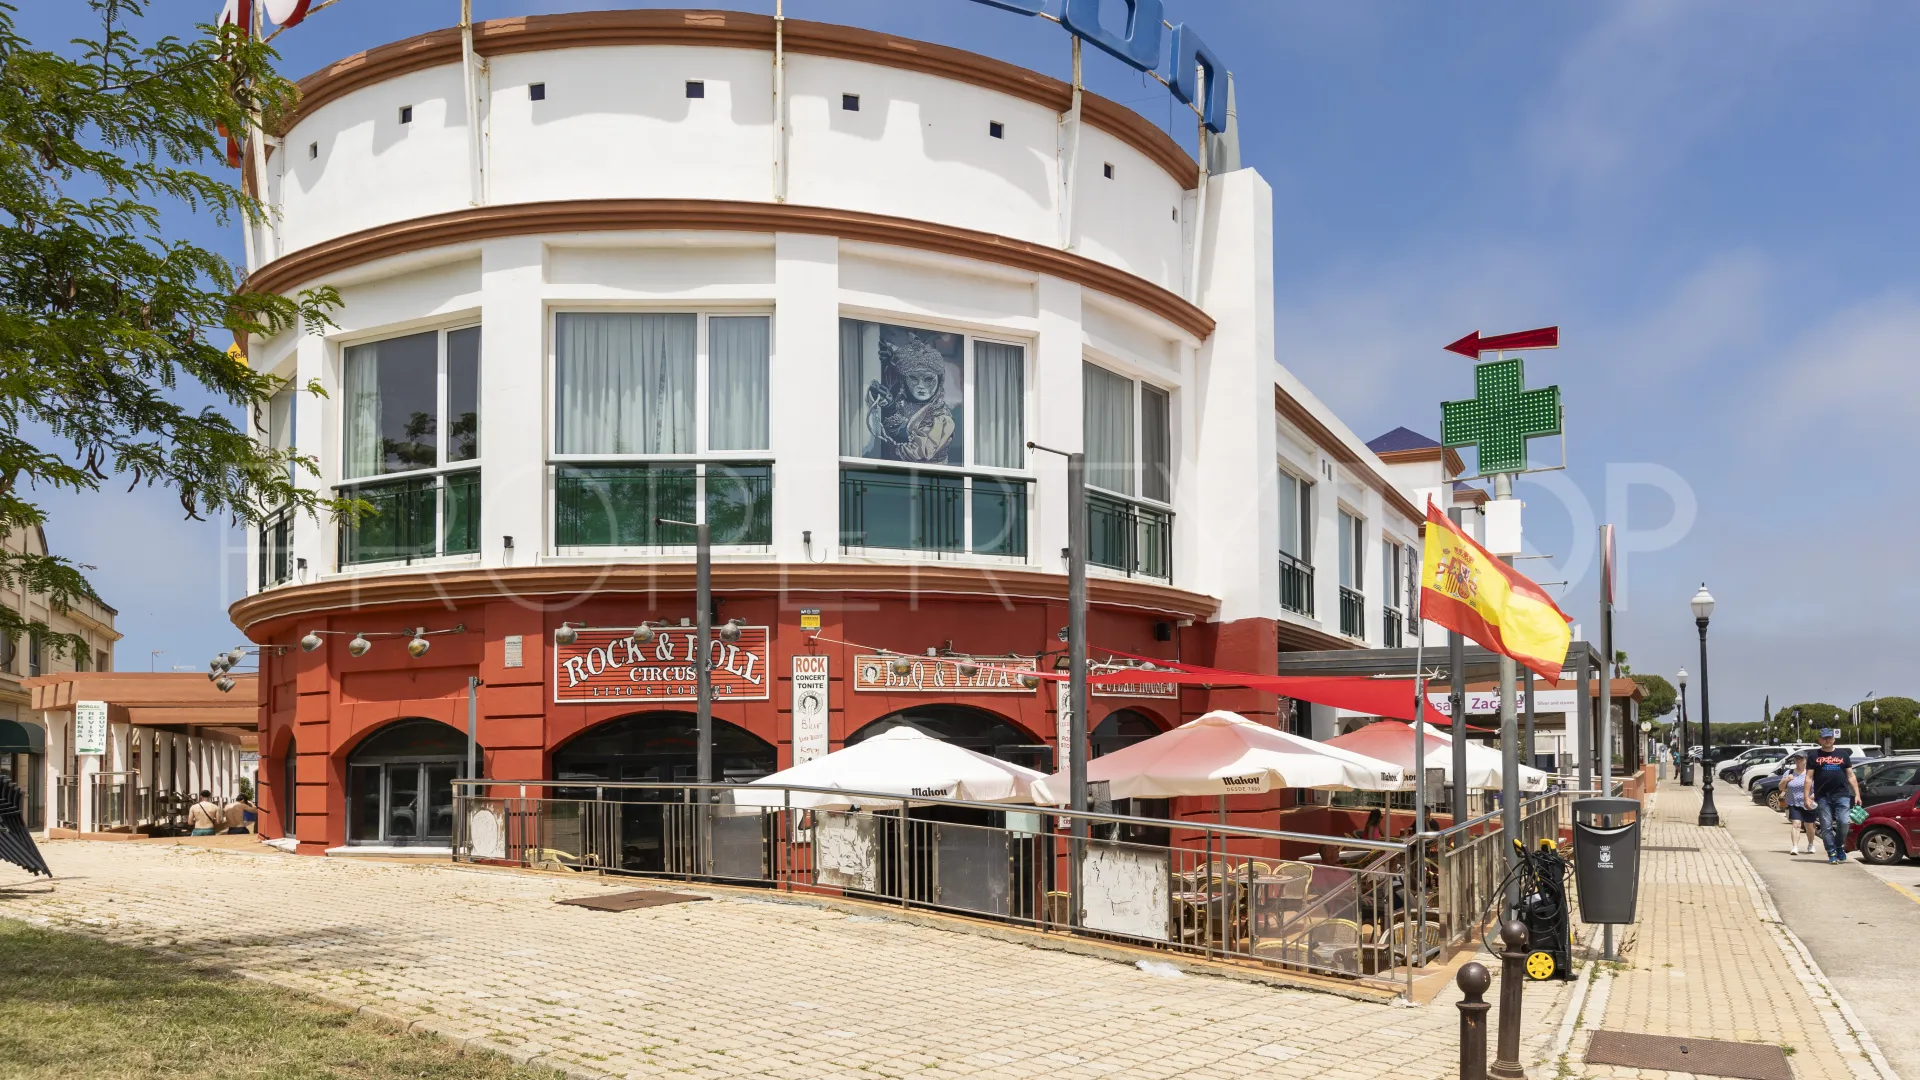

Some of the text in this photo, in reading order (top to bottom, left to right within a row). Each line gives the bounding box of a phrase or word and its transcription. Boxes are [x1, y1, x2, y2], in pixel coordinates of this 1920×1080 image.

[562, 635, 646, 688] ROCK
[655, 632, 675, 661] &
[795, 657, 825, 673] ROCK
[629, 667, 697, 682] CIRCUS
[934, 661, 945, 687] &
[593, 685, 733, 697] LITO'S CORER
[1222, 776, 1260, 786] Mahou
[911, 786, 948, 797] Mahou
